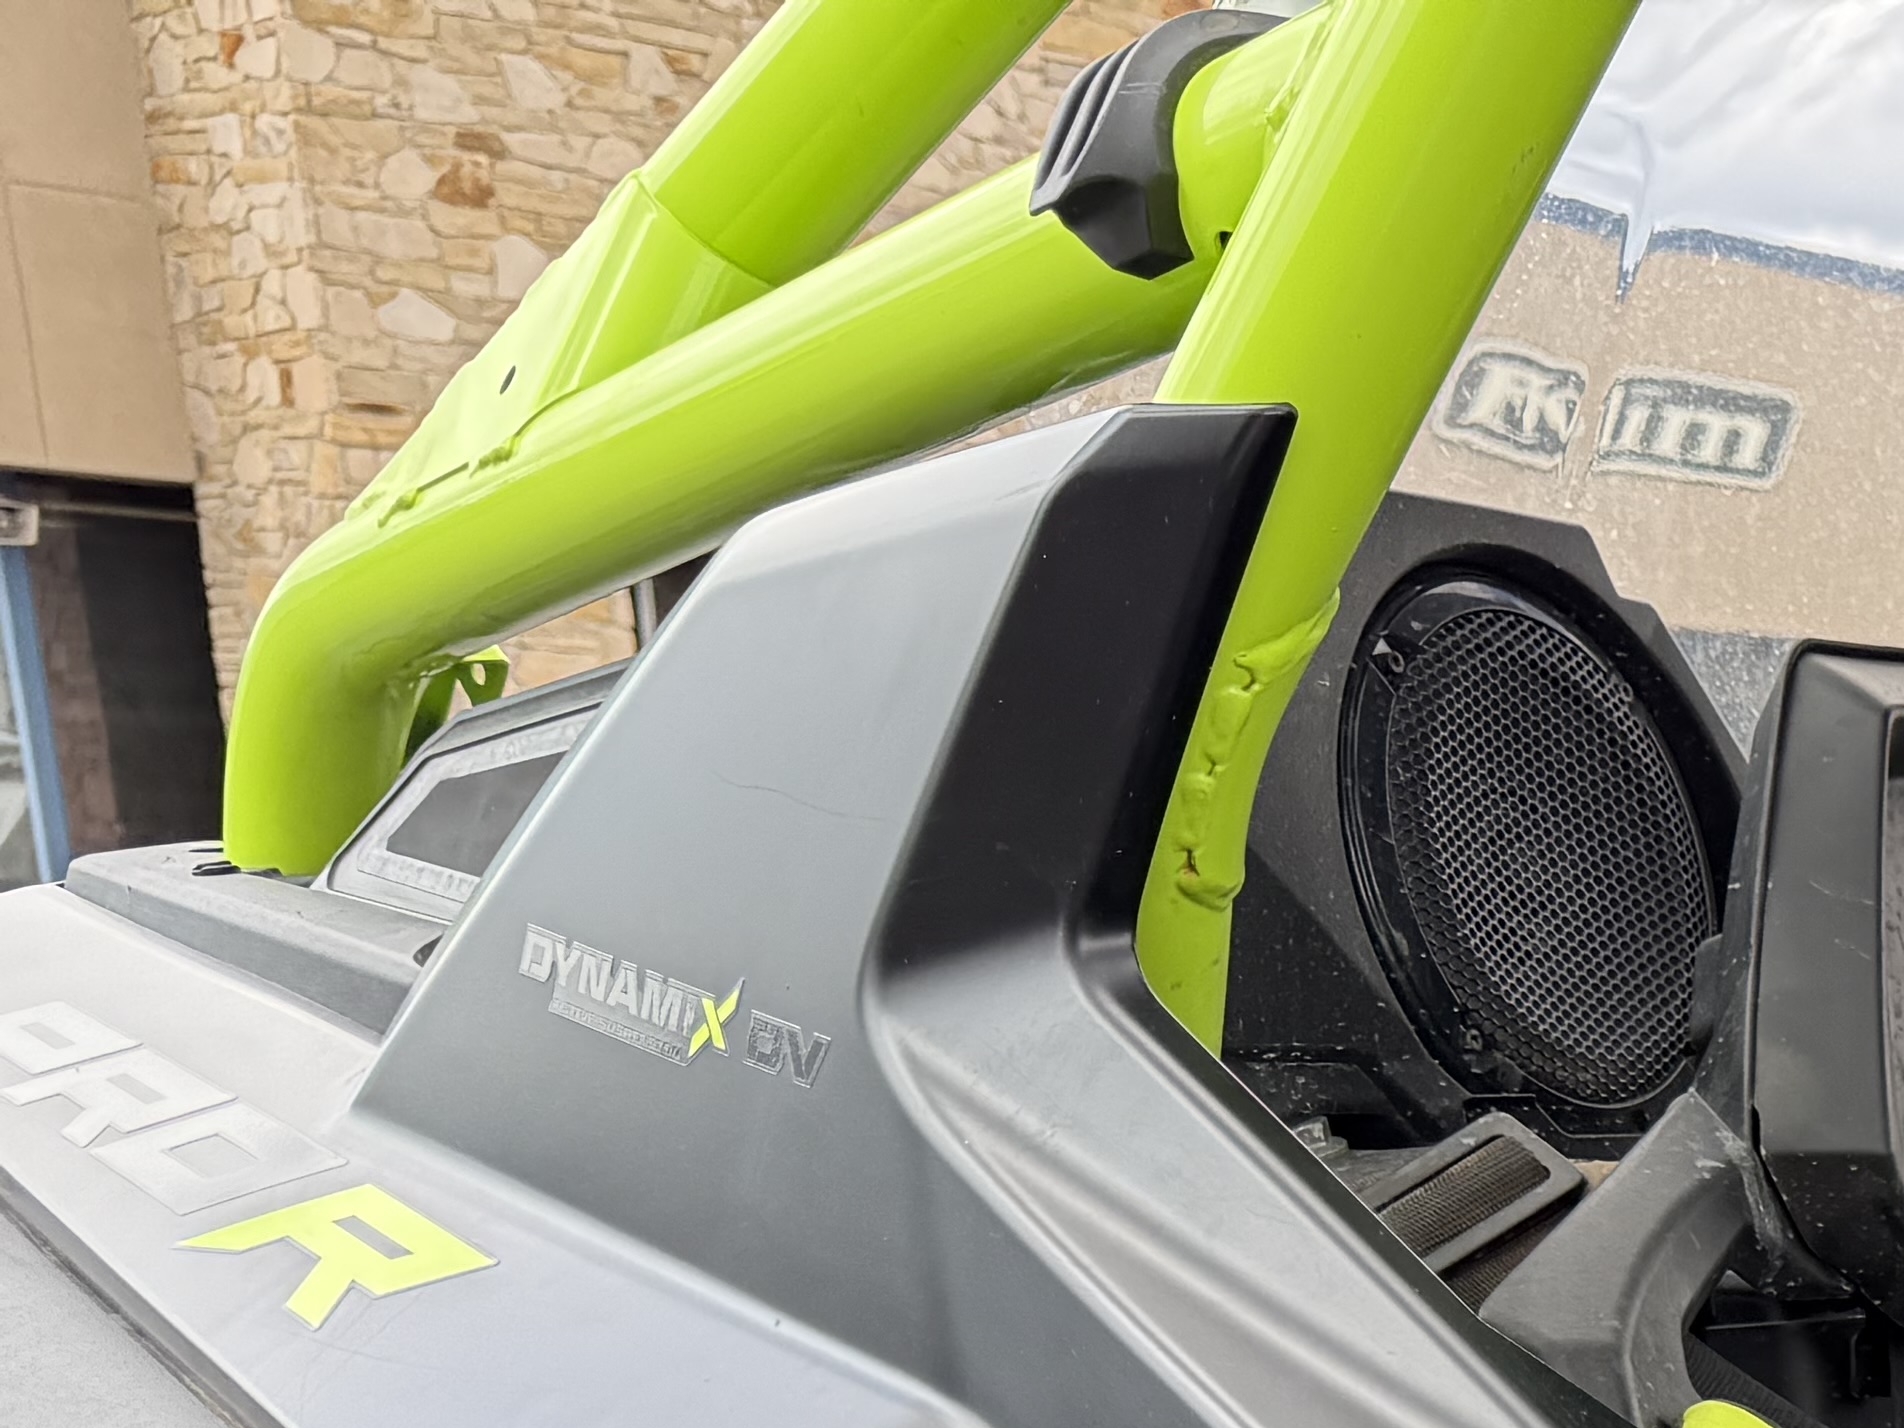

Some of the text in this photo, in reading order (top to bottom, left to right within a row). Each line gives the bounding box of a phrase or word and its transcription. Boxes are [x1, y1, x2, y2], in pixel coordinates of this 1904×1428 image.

[518, 922, 831, 1088] DYNAMIX DV
[172, 1183, 499, 1332] R
